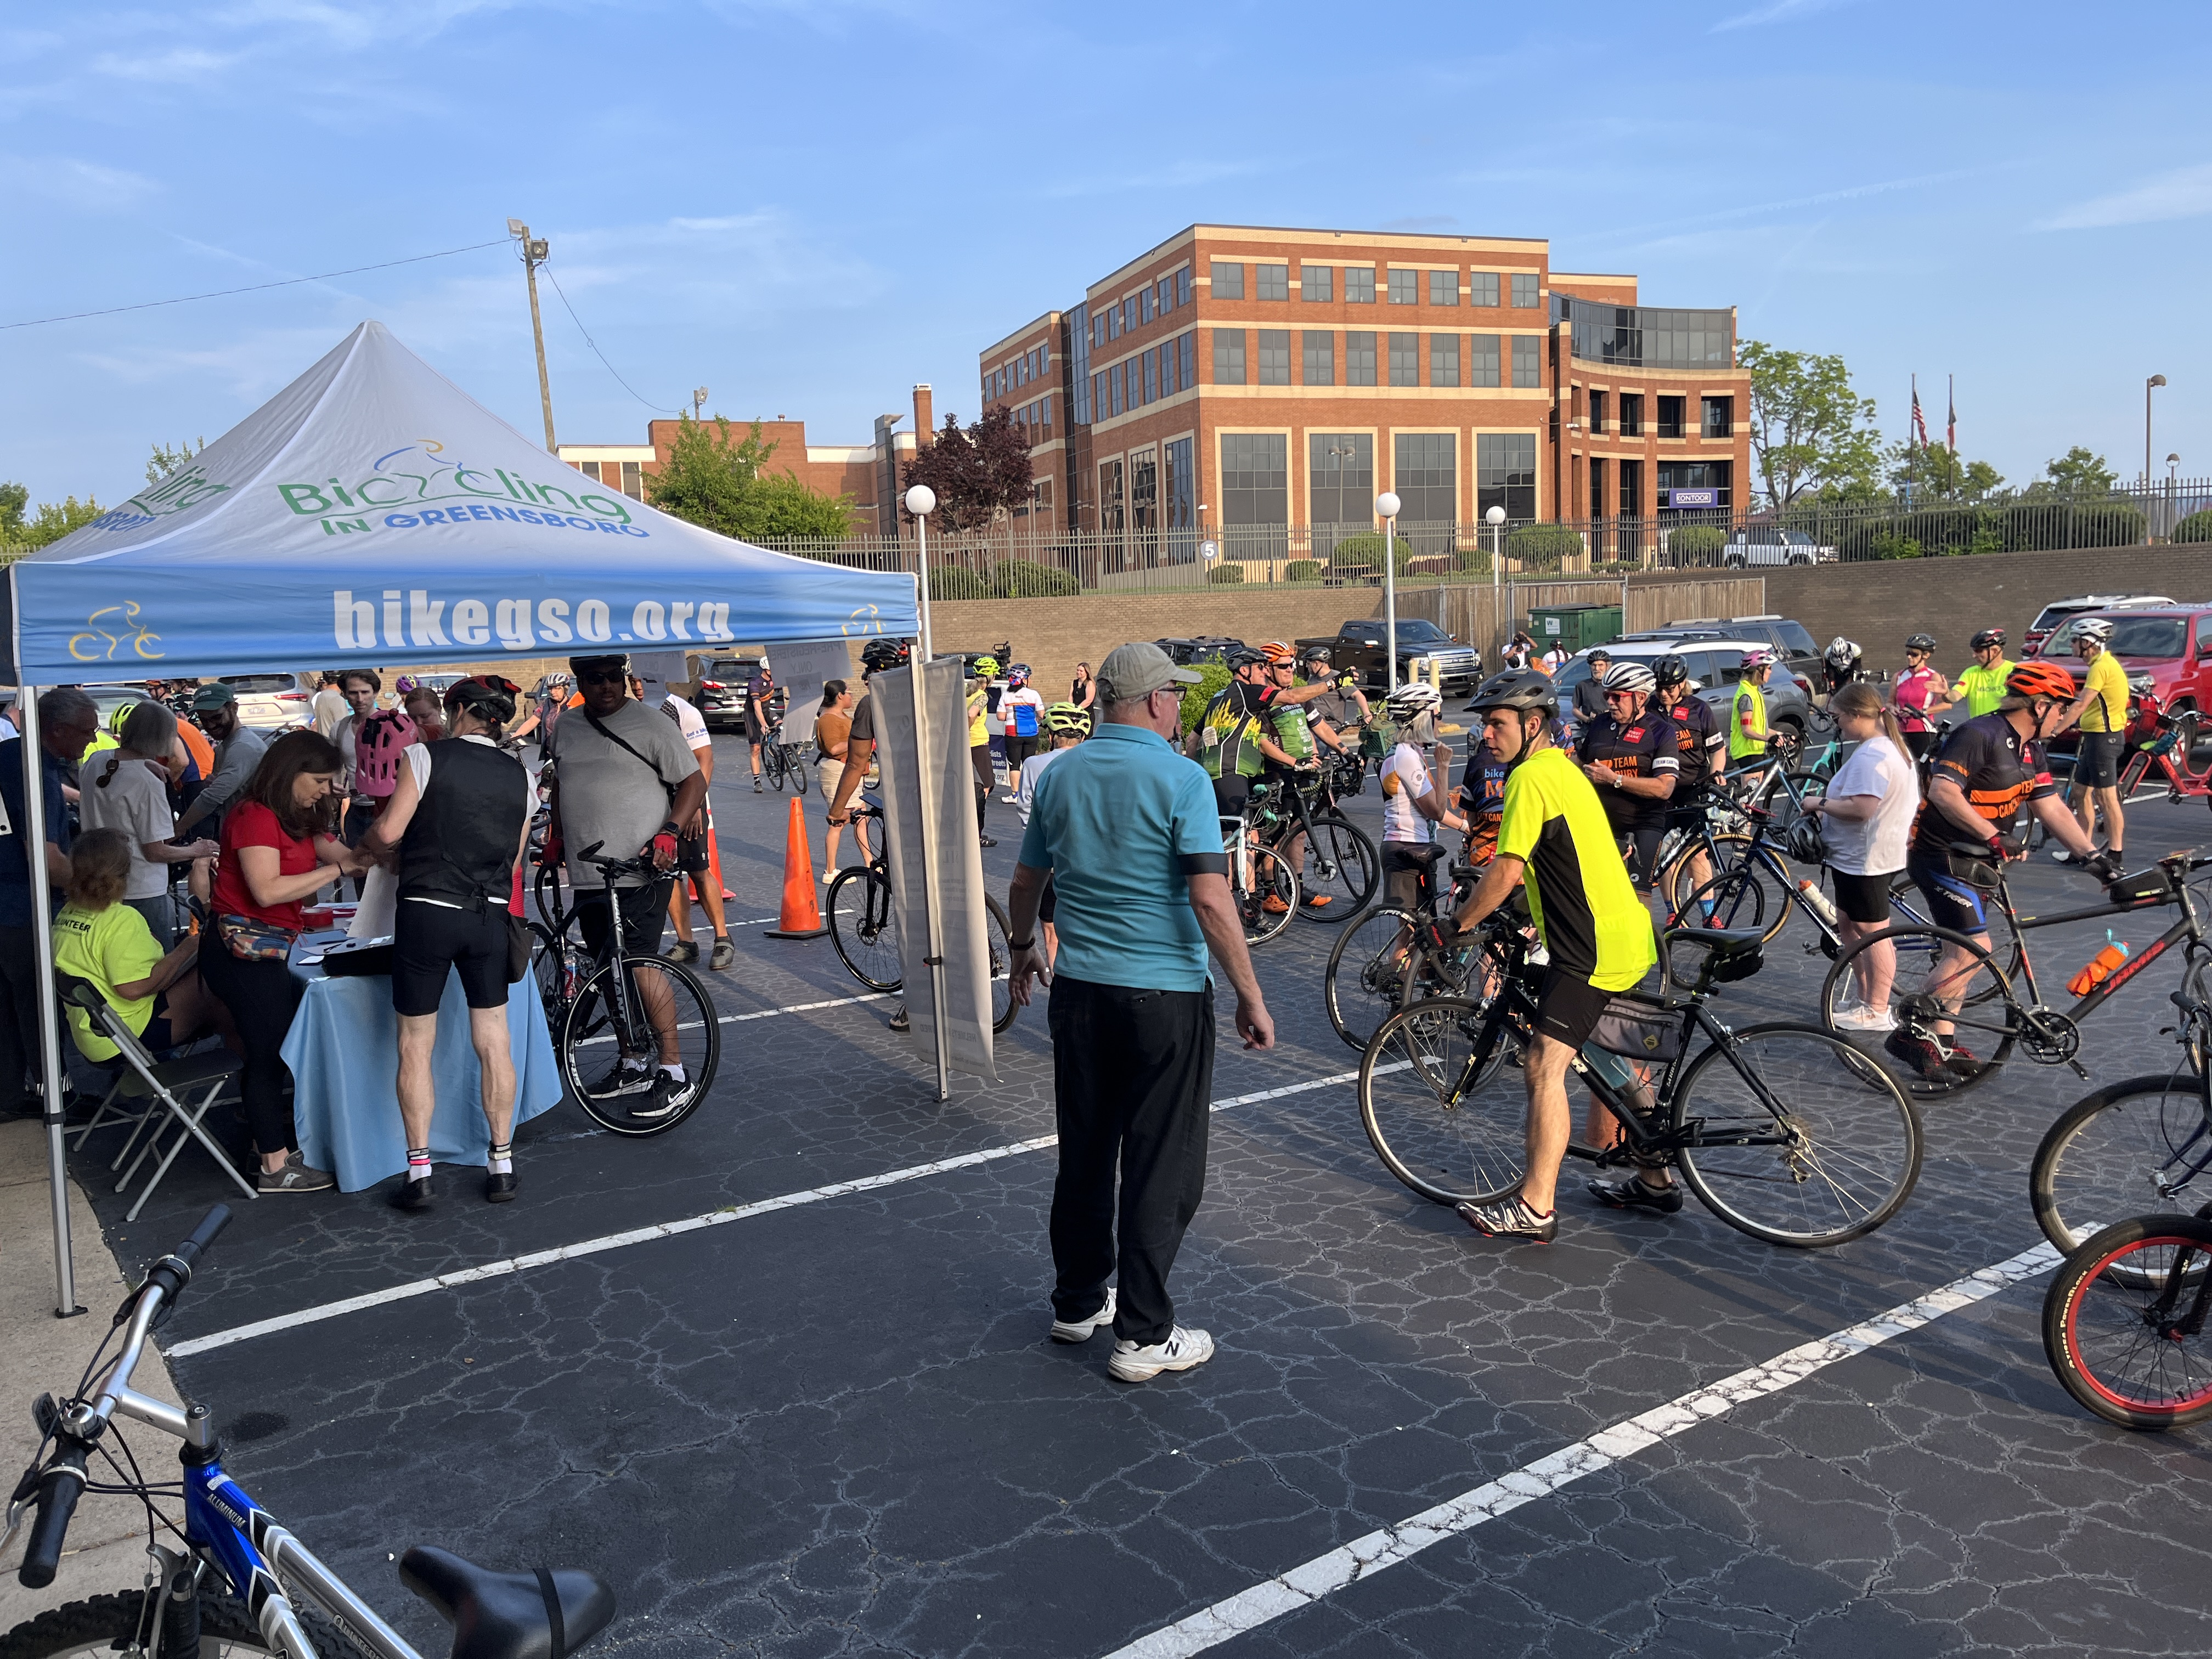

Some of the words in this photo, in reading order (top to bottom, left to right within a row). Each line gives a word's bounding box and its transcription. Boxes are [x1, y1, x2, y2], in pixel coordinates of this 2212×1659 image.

[320, 519, 372, 536] IN
[384, 505, 651, 538] GREENSBORO
[1204, 543, 1215, 557] 5
[334, 590, 735, 651] bikegso.org
[1675, 729, 1691, 741] EAM
[991, 759, 1007, 768] treets
[1613, 755, 1638, 769] TEAM
[1484, 768, 1504, 778] bike
[1485, 780, 1504, 798] M
[613, 893, 624, 935] GIANT
[1163, 1341, 1180, 1358] N
[207, 1493, 246, 1529] ALUMINUM
